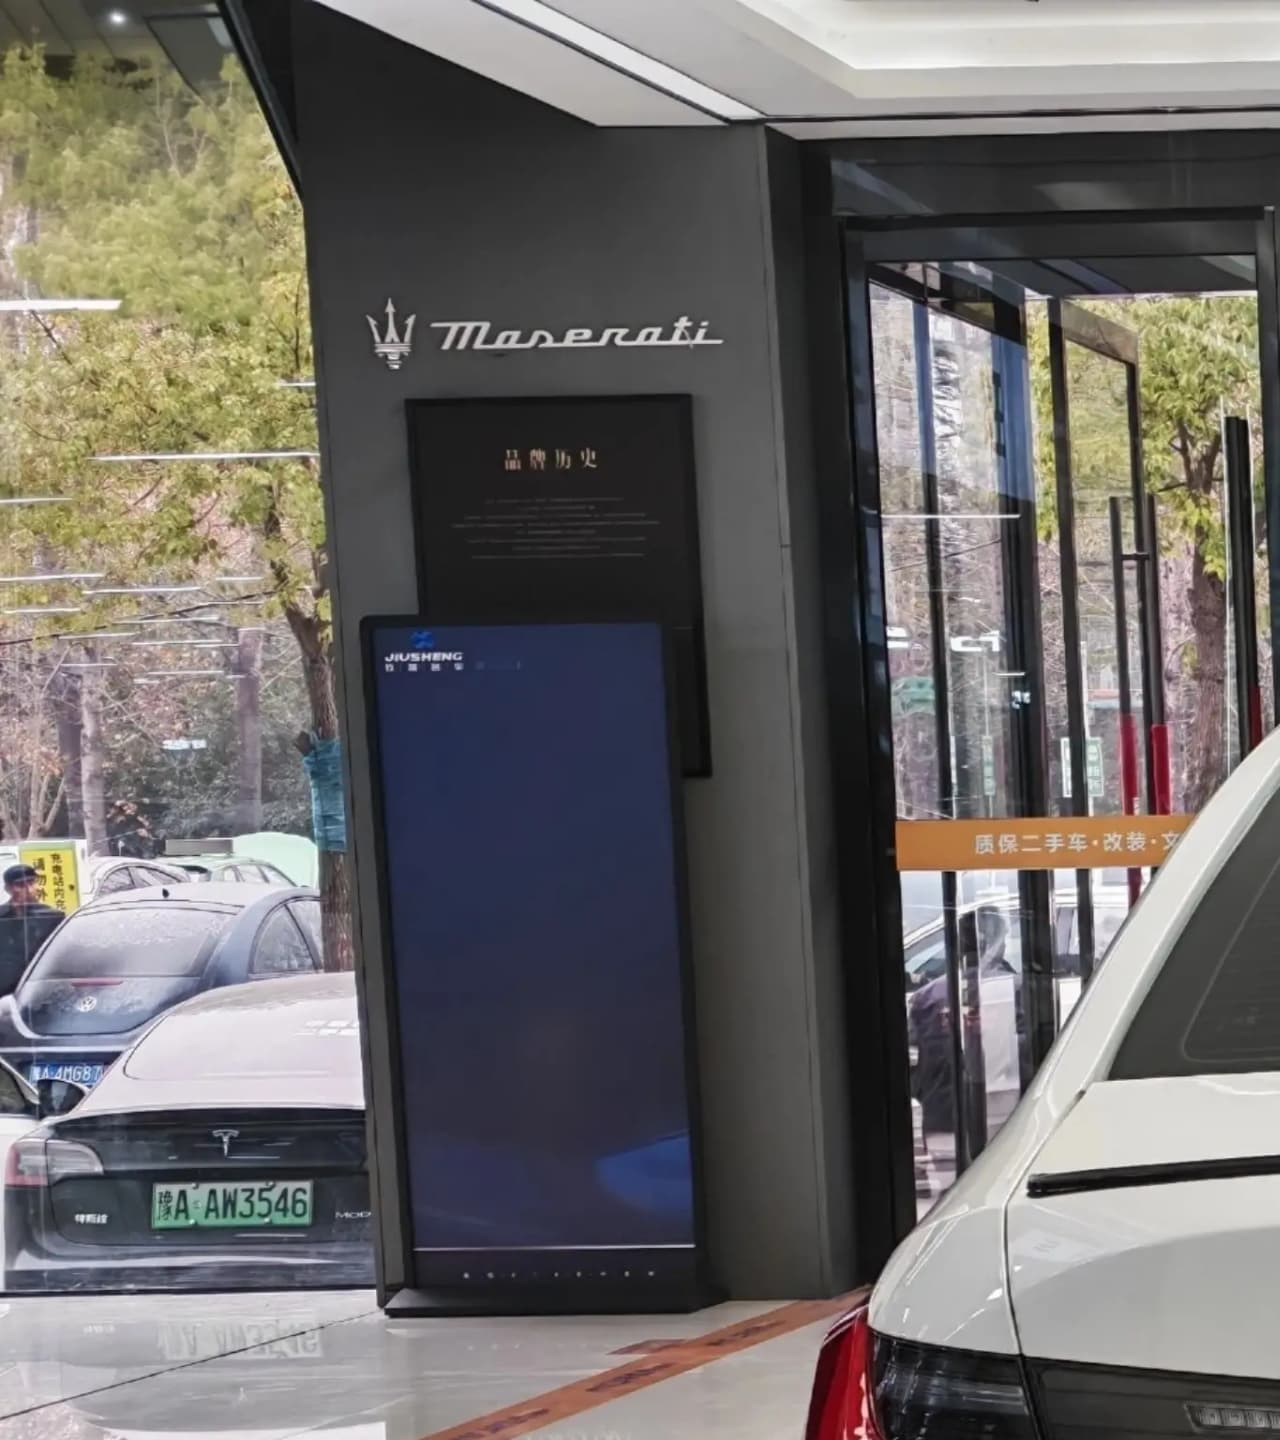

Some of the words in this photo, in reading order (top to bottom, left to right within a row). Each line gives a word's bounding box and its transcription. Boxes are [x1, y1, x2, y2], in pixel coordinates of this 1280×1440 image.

[430, 316, 724, 350] Maserati
[504, 448, 597, 471] 品牌历史
[385, 652, 464, 663] JIUSHENG
